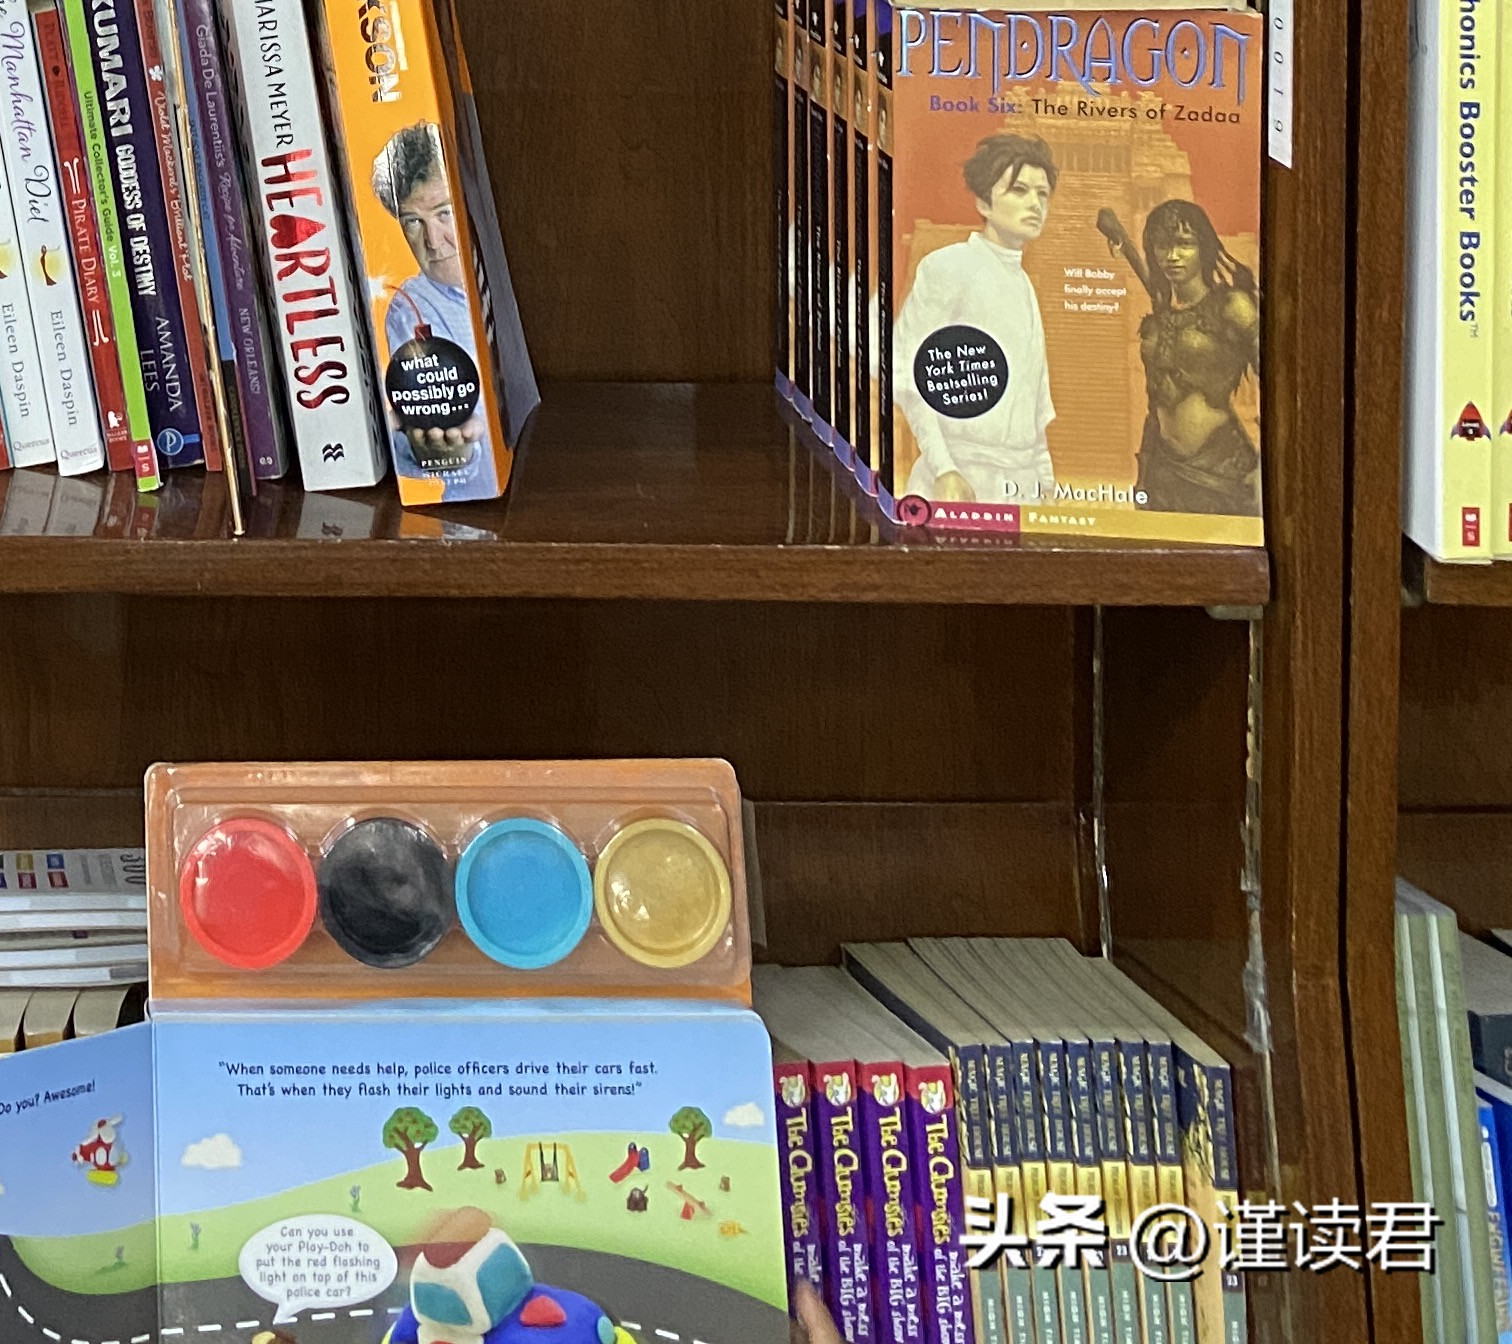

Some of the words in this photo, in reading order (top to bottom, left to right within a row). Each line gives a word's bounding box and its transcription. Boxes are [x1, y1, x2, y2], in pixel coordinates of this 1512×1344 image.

[896, 9, 1252, 106] PENDRAGON
[268, 82, 294, 149] MEYER
[930, 96, 979, 112] Book
[1032, 99, 1068, 116] The
[1077, 101, 1137, 119] Rivers
[1146, 105, 1167, 120] of
[1174, 105, 1241, 124] Zadaa
[1457, 101, 1478, 221] Booster
[401, 354, 439, 371] what
[928, 349, 951, 362] The
[956, 344, 986, 359] New
[417, 367, 458, 384] could
[925, 365, 954, 378] York
[958, 358, 995, 374] Times
[392, 385, 454, 402] possibly
[458, 382, 475, 397] go
[926, 374, 998, 392] Bestselling
[942, 390, 988, 406] Series!
[1053, 483, 1148, 505] MacHale
[269, 1063, 328, 1076] someone
[332, 1062, 372, 1076] needs
[376, 1062, 408, 1078] help,
[414, 1060, 452, 1078] police
[456, 1060, 510, 1076] officers
[514, 1060, 550, 1076] drive
[555, 1060, 588, 1076] their
[594, 1062, 624, 1076] cars
[628, 1060, 658, 1076] fast.
